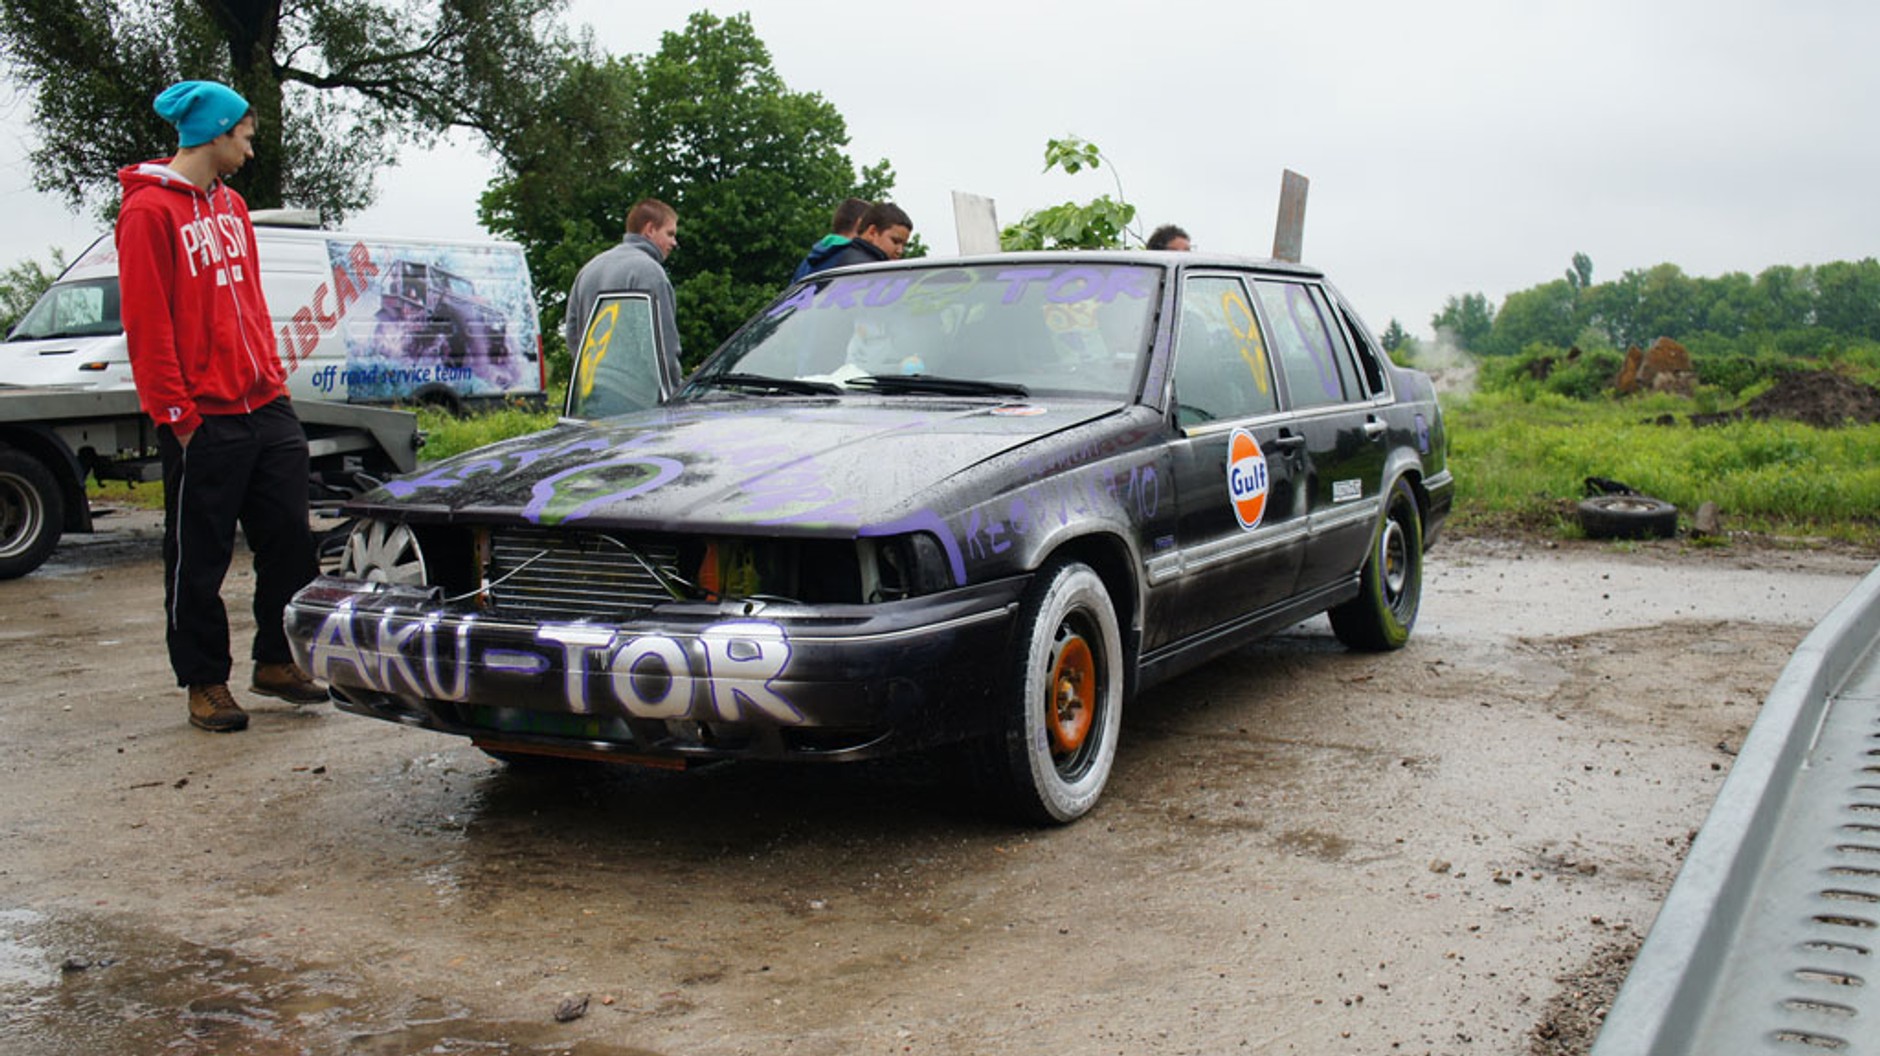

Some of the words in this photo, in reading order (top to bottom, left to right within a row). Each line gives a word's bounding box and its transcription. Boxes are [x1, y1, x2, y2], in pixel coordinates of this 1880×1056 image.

[766, 277, 914, 317] AKU
[996, 267, 1150, 304] TOR
[312, 365, 337, 392] off
[340, 364, 378, 386] road
[382, 363, 431, 385] service
[435, 364, 472, 383] team
[1231, 462, 1265, 496] Gulf
